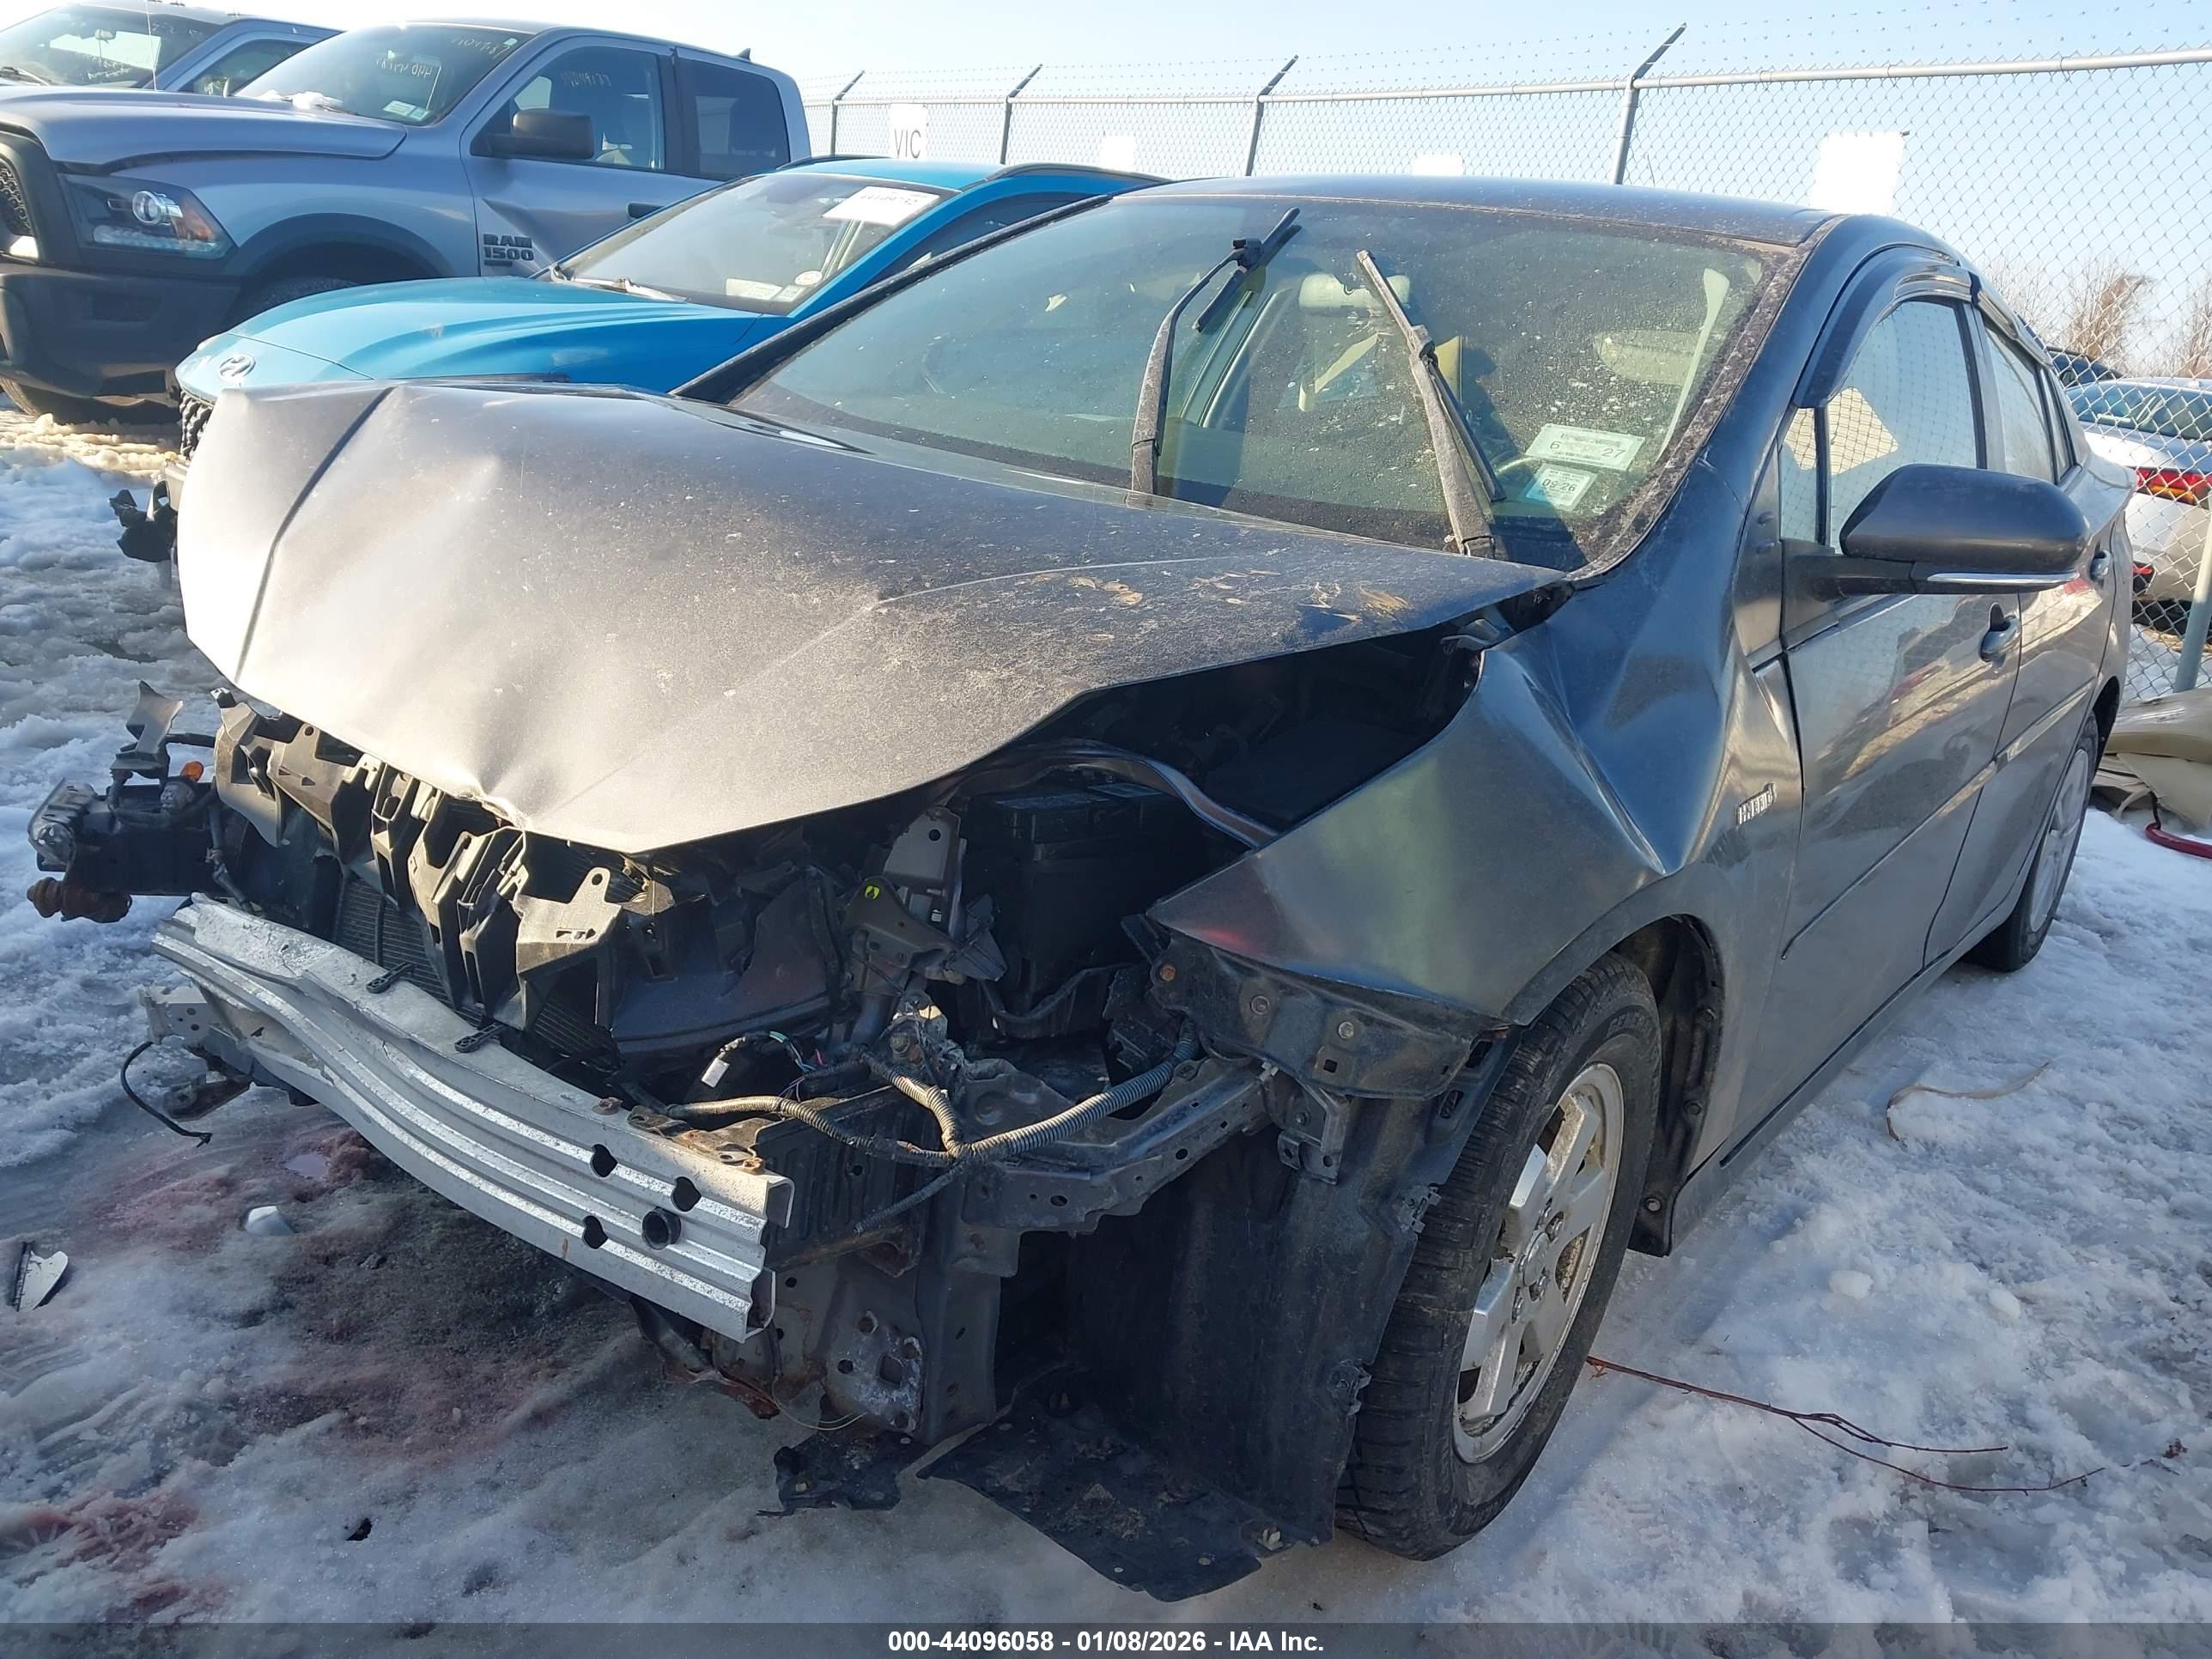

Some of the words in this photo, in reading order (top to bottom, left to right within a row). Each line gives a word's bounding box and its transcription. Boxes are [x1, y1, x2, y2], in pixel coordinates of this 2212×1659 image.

[894, 129, 921, 159] VIC
[483, 234, 532, 249] RAM
[484, 246, 534, 261] 1500
[1601, 447, 1626, 459] 27
